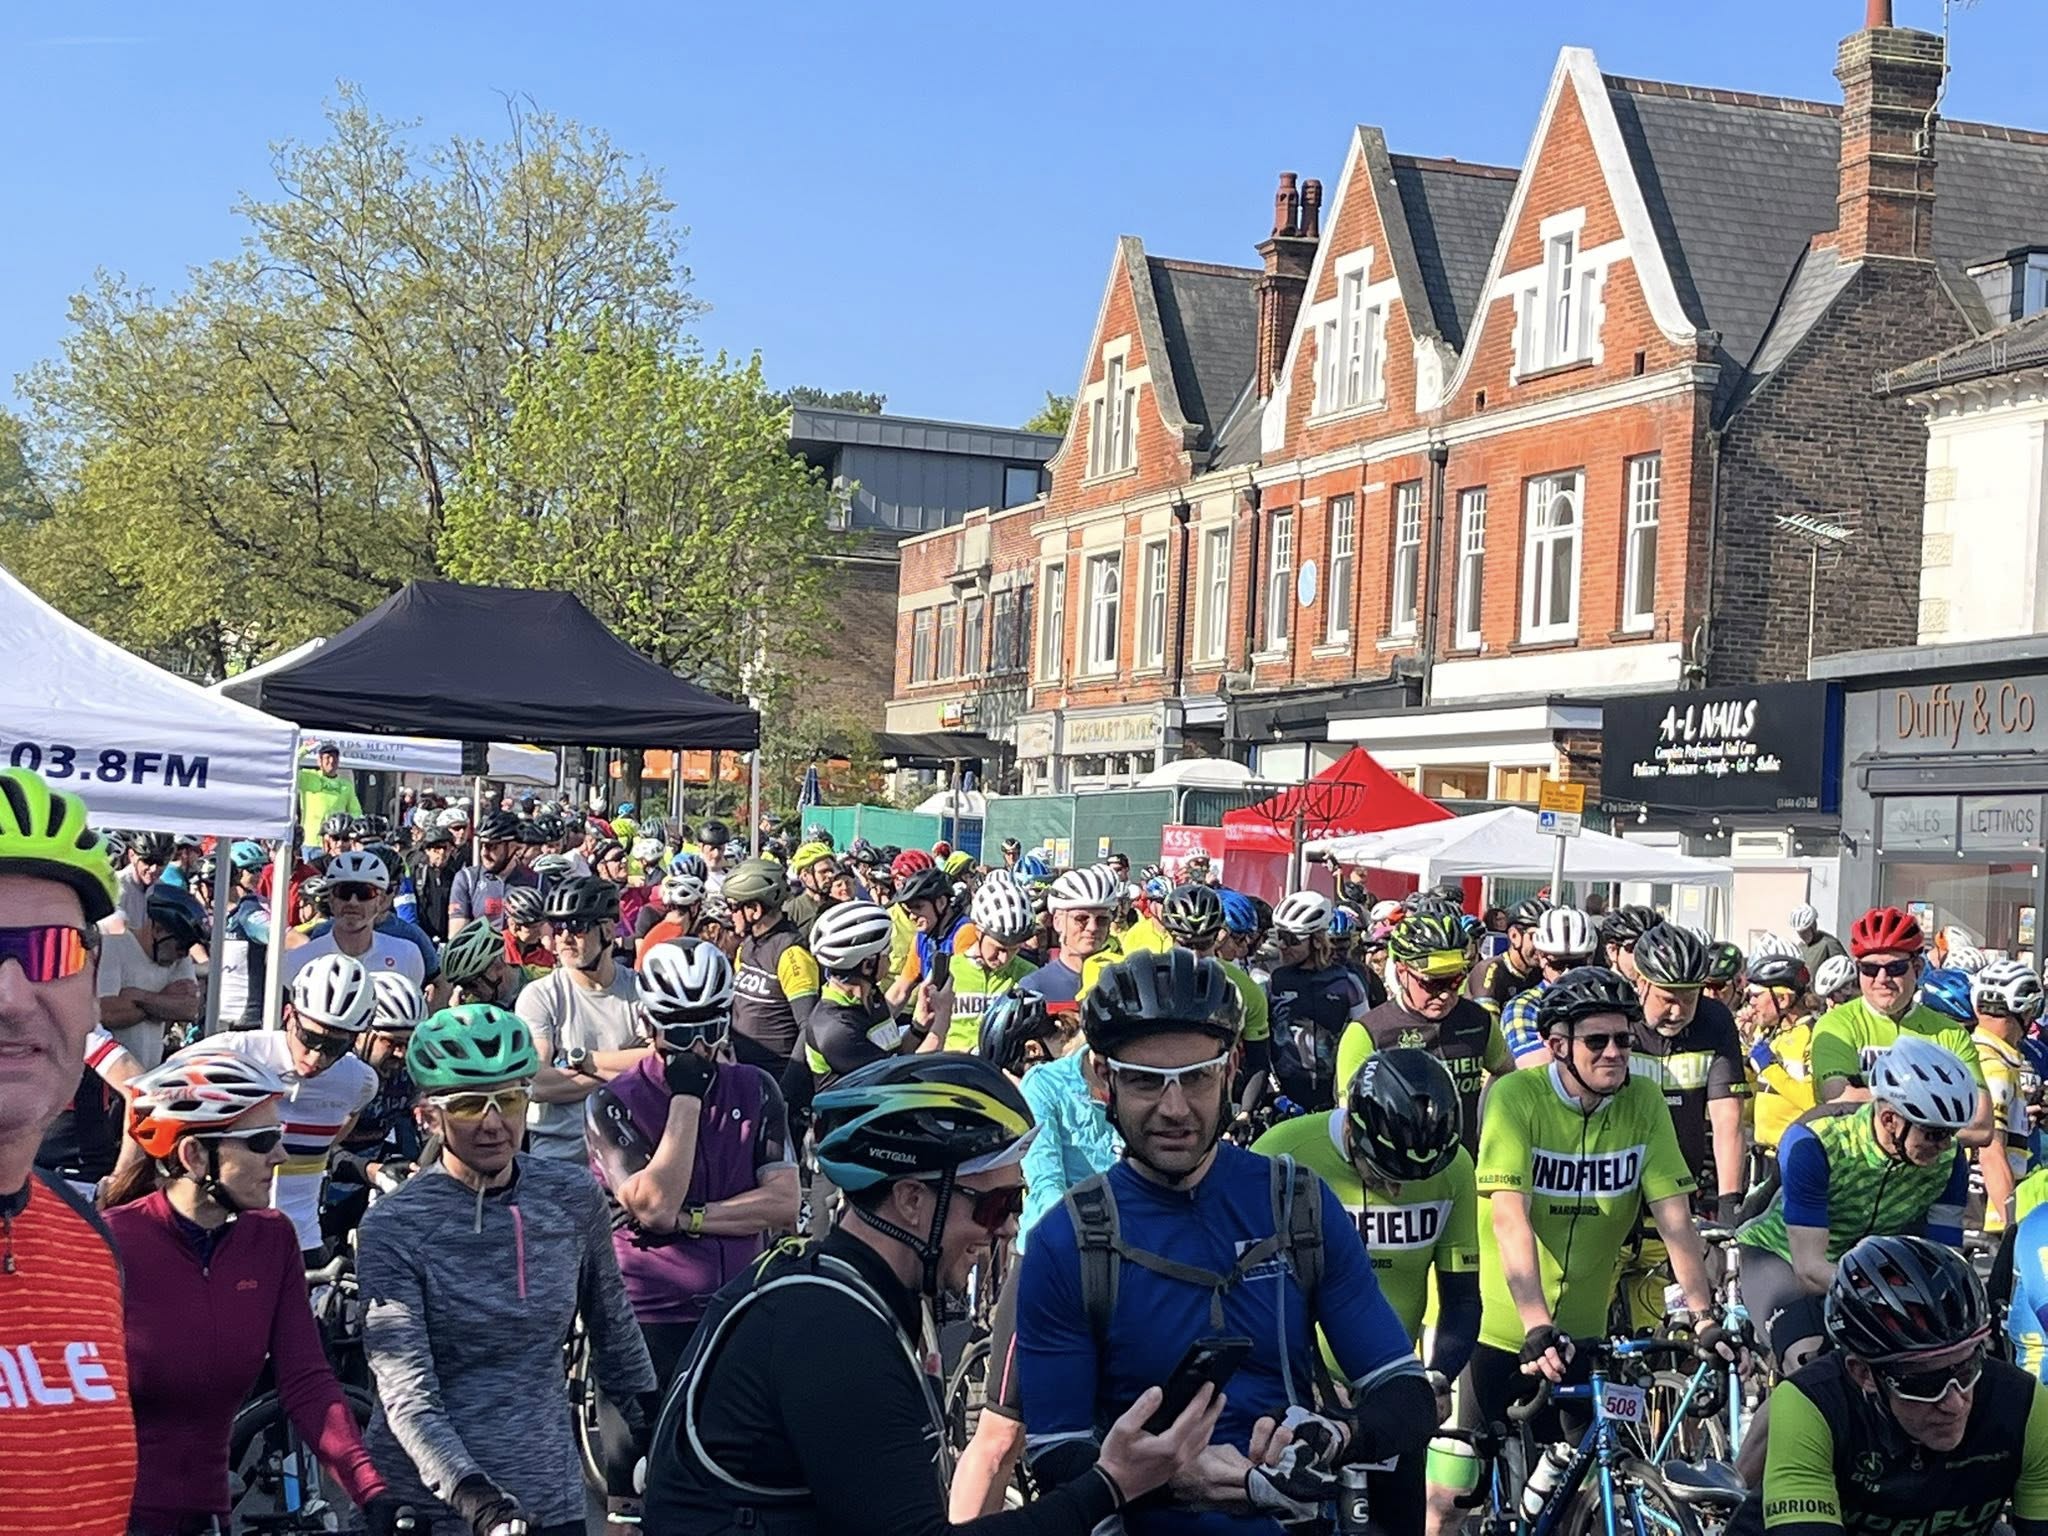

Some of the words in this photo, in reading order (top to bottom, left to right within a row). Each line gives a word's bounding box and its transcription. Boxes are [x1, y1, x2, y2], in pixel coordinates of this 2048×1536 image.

[1700, 699, 1758, 739] NAILS
[1896, 684, 1965, 749] Duffy
[1973, 683, 1991, 735] &
[1998, 681, 2035, 733] Co
[0, 740, 210, 789] 03.8FM
[1899, 808, 1941, 833] SALES
[1970, 808, 2035, 833] LETTINGS
[1165, 830, 1192, 848] KSS
[869, 1147, 917, 1165] VICTGOAL
[1533, 1152, 1638, 1192] INDFIELD
[1606, 1396, 1637, 1417] 508
[1766, 1499, 1837, 1518] WARRIORS
